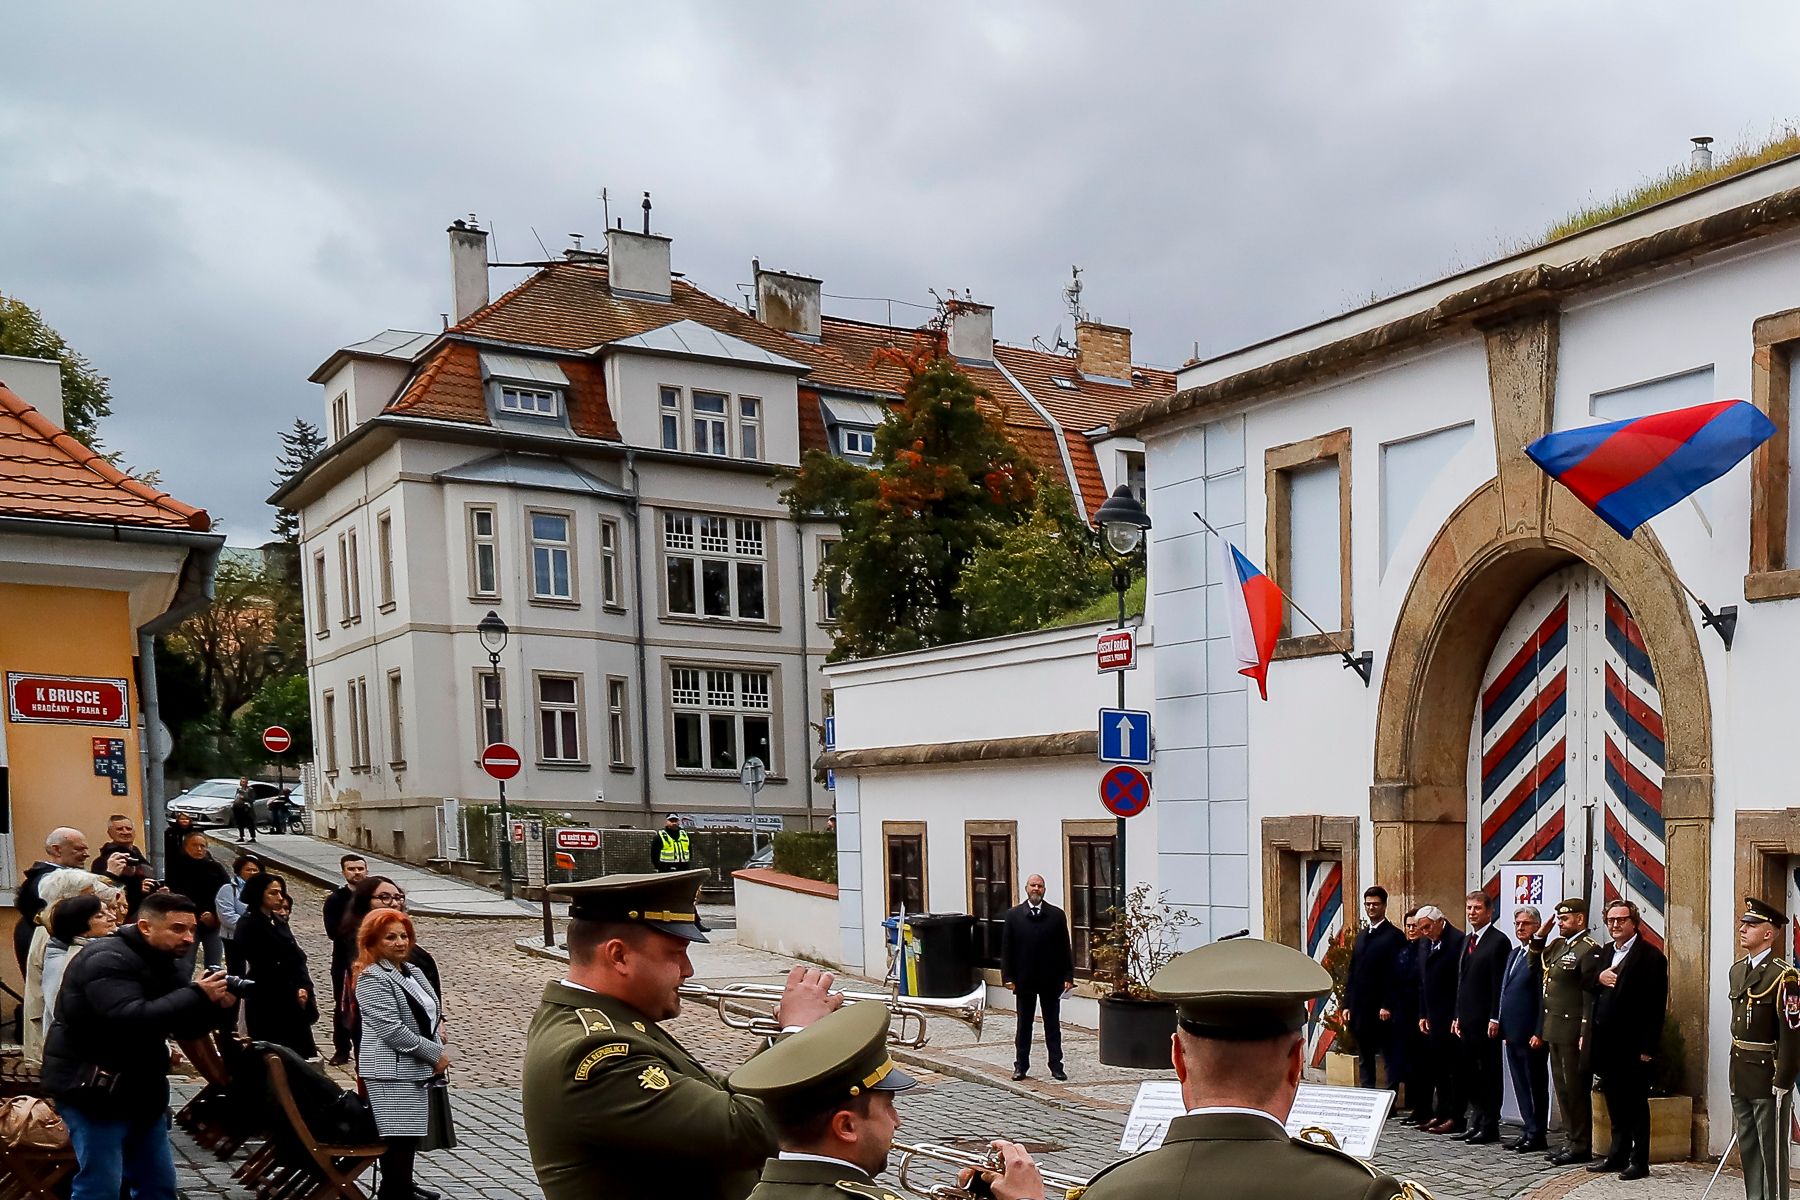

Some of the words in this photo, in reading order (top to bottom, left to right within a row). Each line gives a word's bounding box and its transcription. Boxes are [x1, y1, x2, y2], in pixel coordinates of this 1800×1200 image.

[36, 687, 45, 702] K
[48, 688, 101, 705] BRUSCE
[31, 702, 70, 713] HRADČANY
[76, 706, 100, 715] PRAHA
